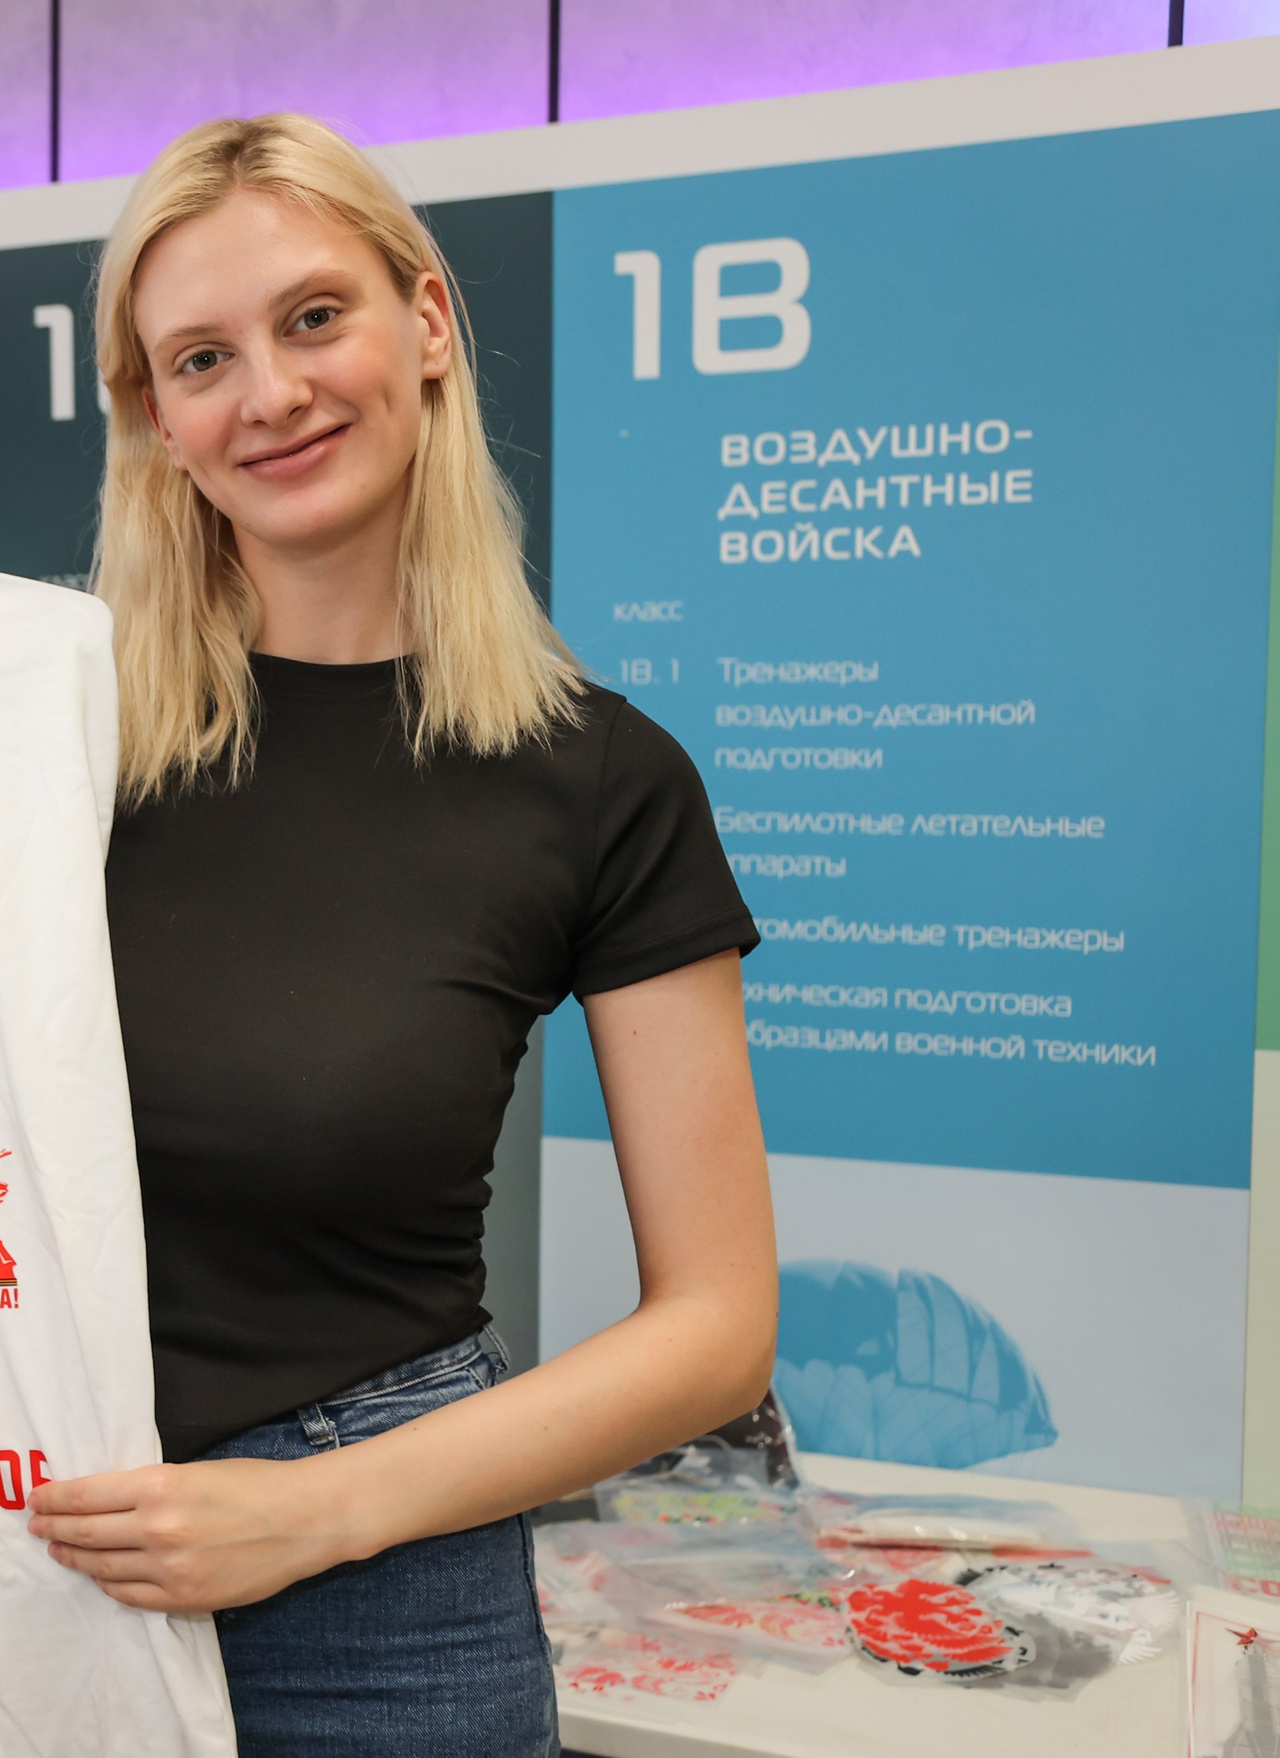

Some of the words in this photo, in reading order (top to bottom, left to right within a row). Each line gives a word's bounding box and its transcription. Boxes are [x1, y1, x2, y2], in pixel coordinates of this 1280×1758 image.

[33, 303, 111, 421] 1
[720, 418, 1034, 468] ВОЗДУШНО-
[716, 468, 1034, 521] ДЕСАНТНЫЕ
[719, 521, 922, 565] ВОЙСКА
[613, 600, 684, 623] класс
[715, 656, 881, 690] Тренажеры
[715, 699, 1037, 731] воздушно-десантной
[714, 747, 884, 773] подготовки
[714, 805, 905, 837] Беспилотные
[909, 813, 1107, 839] летательные
[726, 853, 848, 880] ппараты
[951, 923, 1126, 957] тренажеры
[742, 980, 888, 1010] хническая
[893, 987, 1074, 1016] подготовка
[745, 1018, 889, 1054] бразцами
[894, 1031, 1026, 1060] военной
[1031, 1038, 1157, 1067] техники
